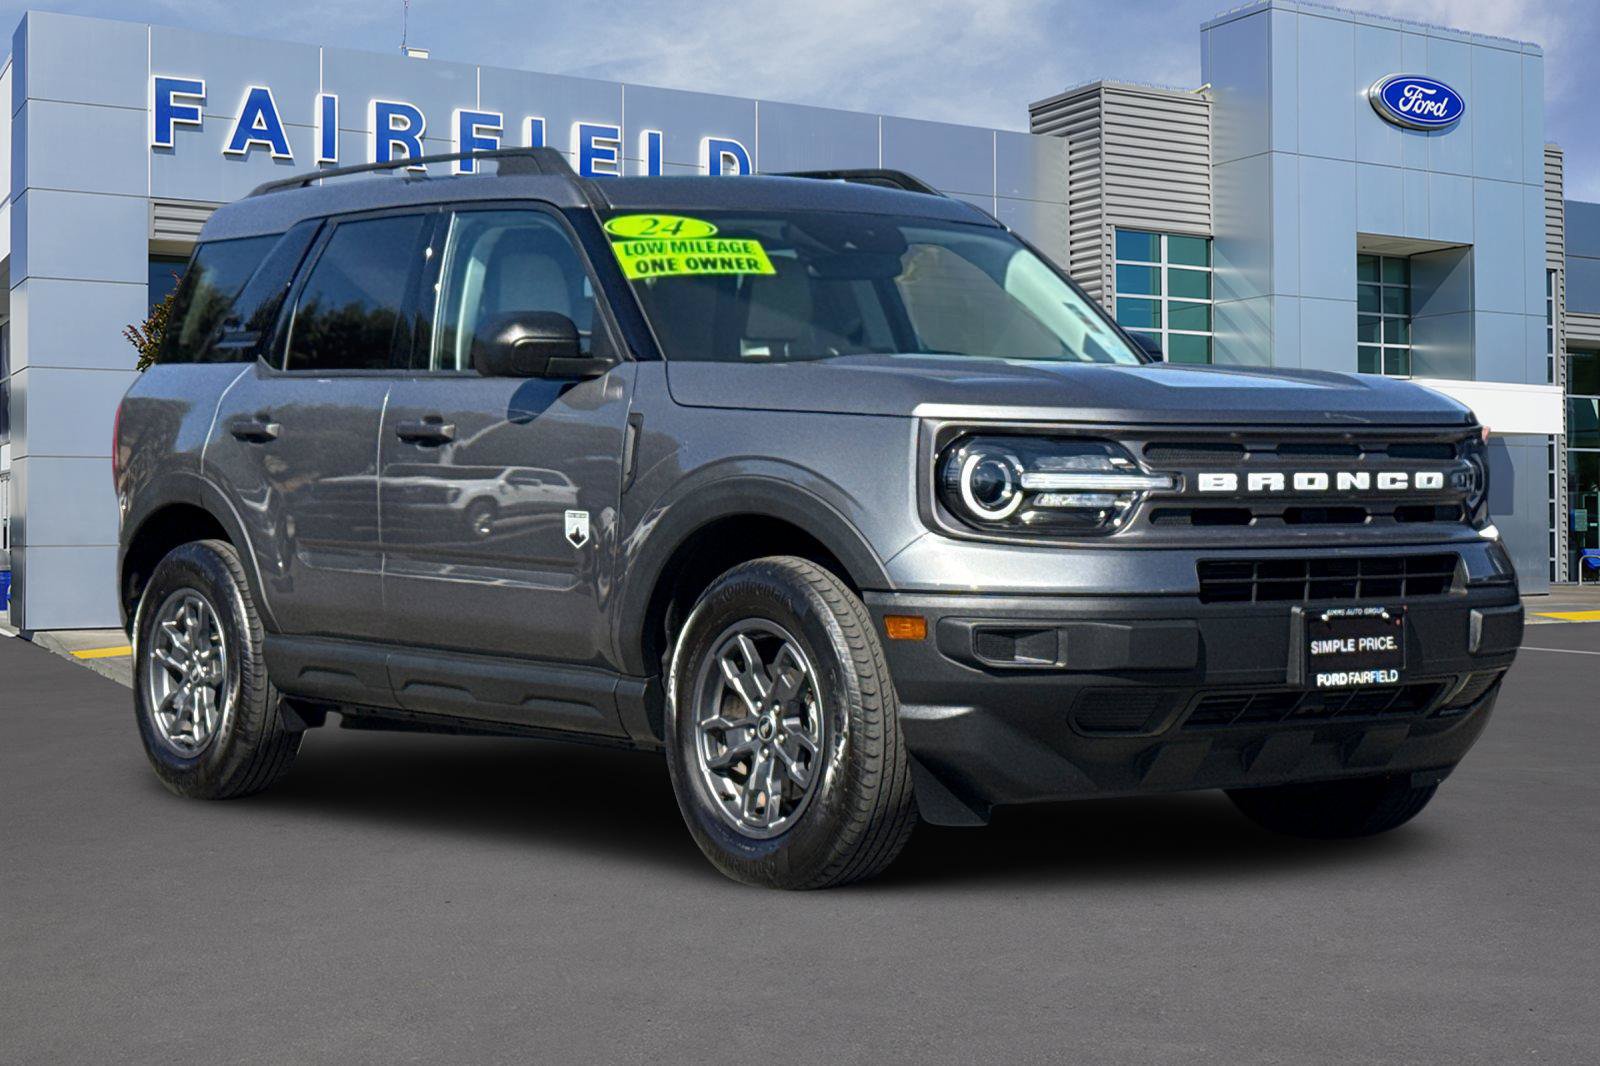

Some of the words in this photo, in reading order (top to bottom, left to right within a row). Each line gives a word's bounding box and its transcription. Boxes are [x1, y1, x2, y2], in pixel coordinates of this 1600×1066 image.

[1399, 84, 1448, 117] Ford
[151, 74, 752, 177] FAIRFIELD
[639, 217, 685, 236] 24
[624, 242, 664, 257] LOW
[670, 241, 753, 255] MILEAGE
[635, 258, 680, 274] ONE
[685, 257, 761, 271] OWNER
[1198, 472, 1444, 492] BRONCO
[1310, 639, 1356, 655] SIMPLE
[1316, 672, 1348, 688] FORD
[1348, 669, 1399, 685] FAIRFIELD
